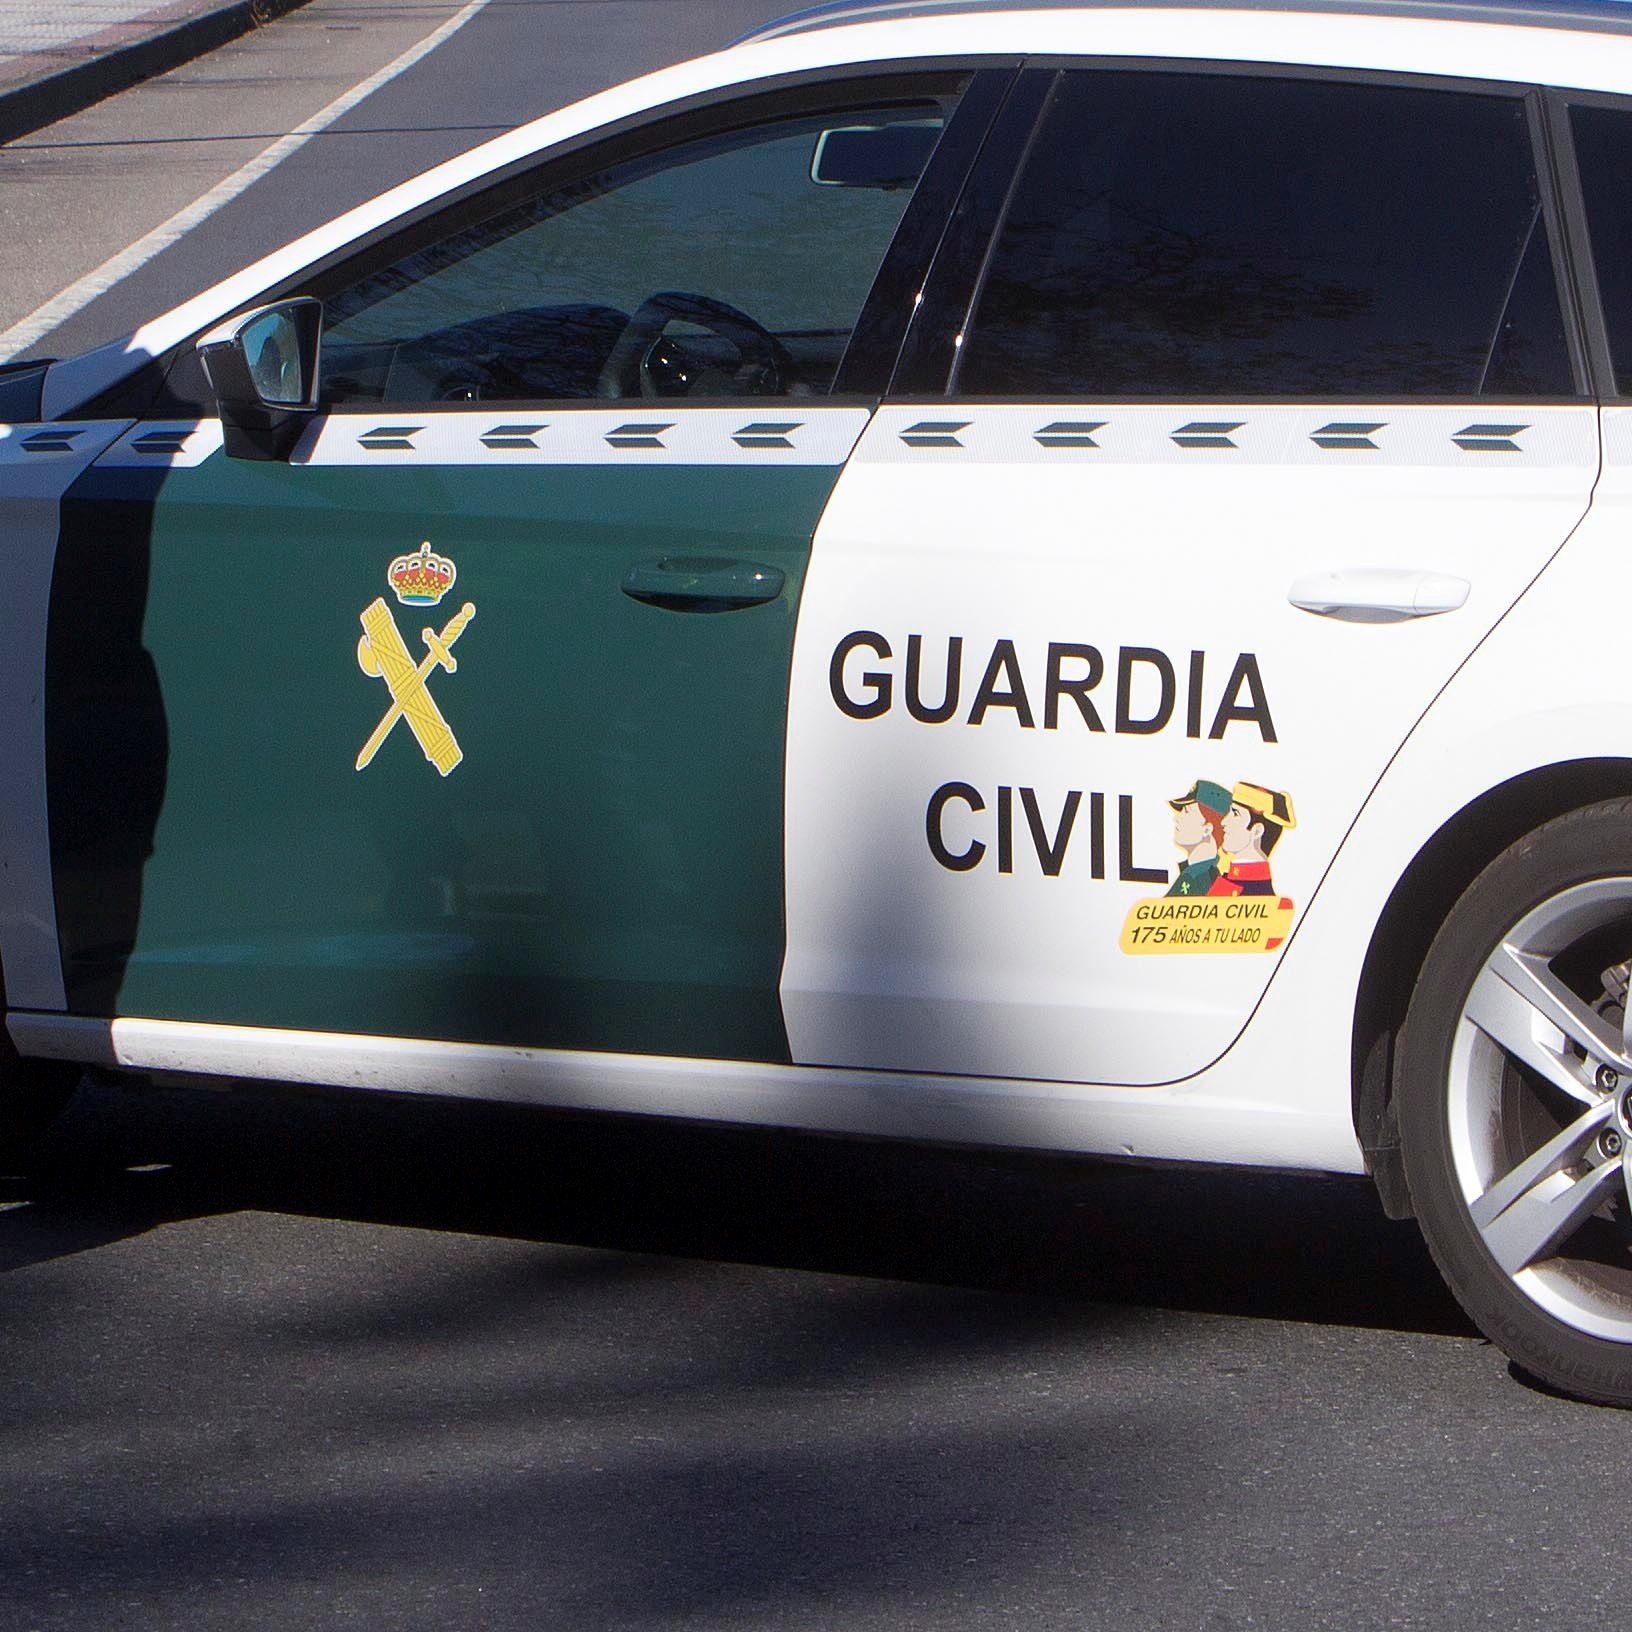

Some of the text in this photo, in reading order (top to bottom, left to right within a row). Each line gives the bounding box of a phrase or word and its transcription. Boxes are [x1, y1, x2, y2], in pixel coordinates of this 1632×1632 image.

[829, 629, 1279, 744] GUARDIA
[925, 781, 1170, 885] CIVIL
[1130, 924, 1262, 944] 175 AÑOS A TU LADO
[1136, 904, 1270, 920] GUARDIA CIVIL
